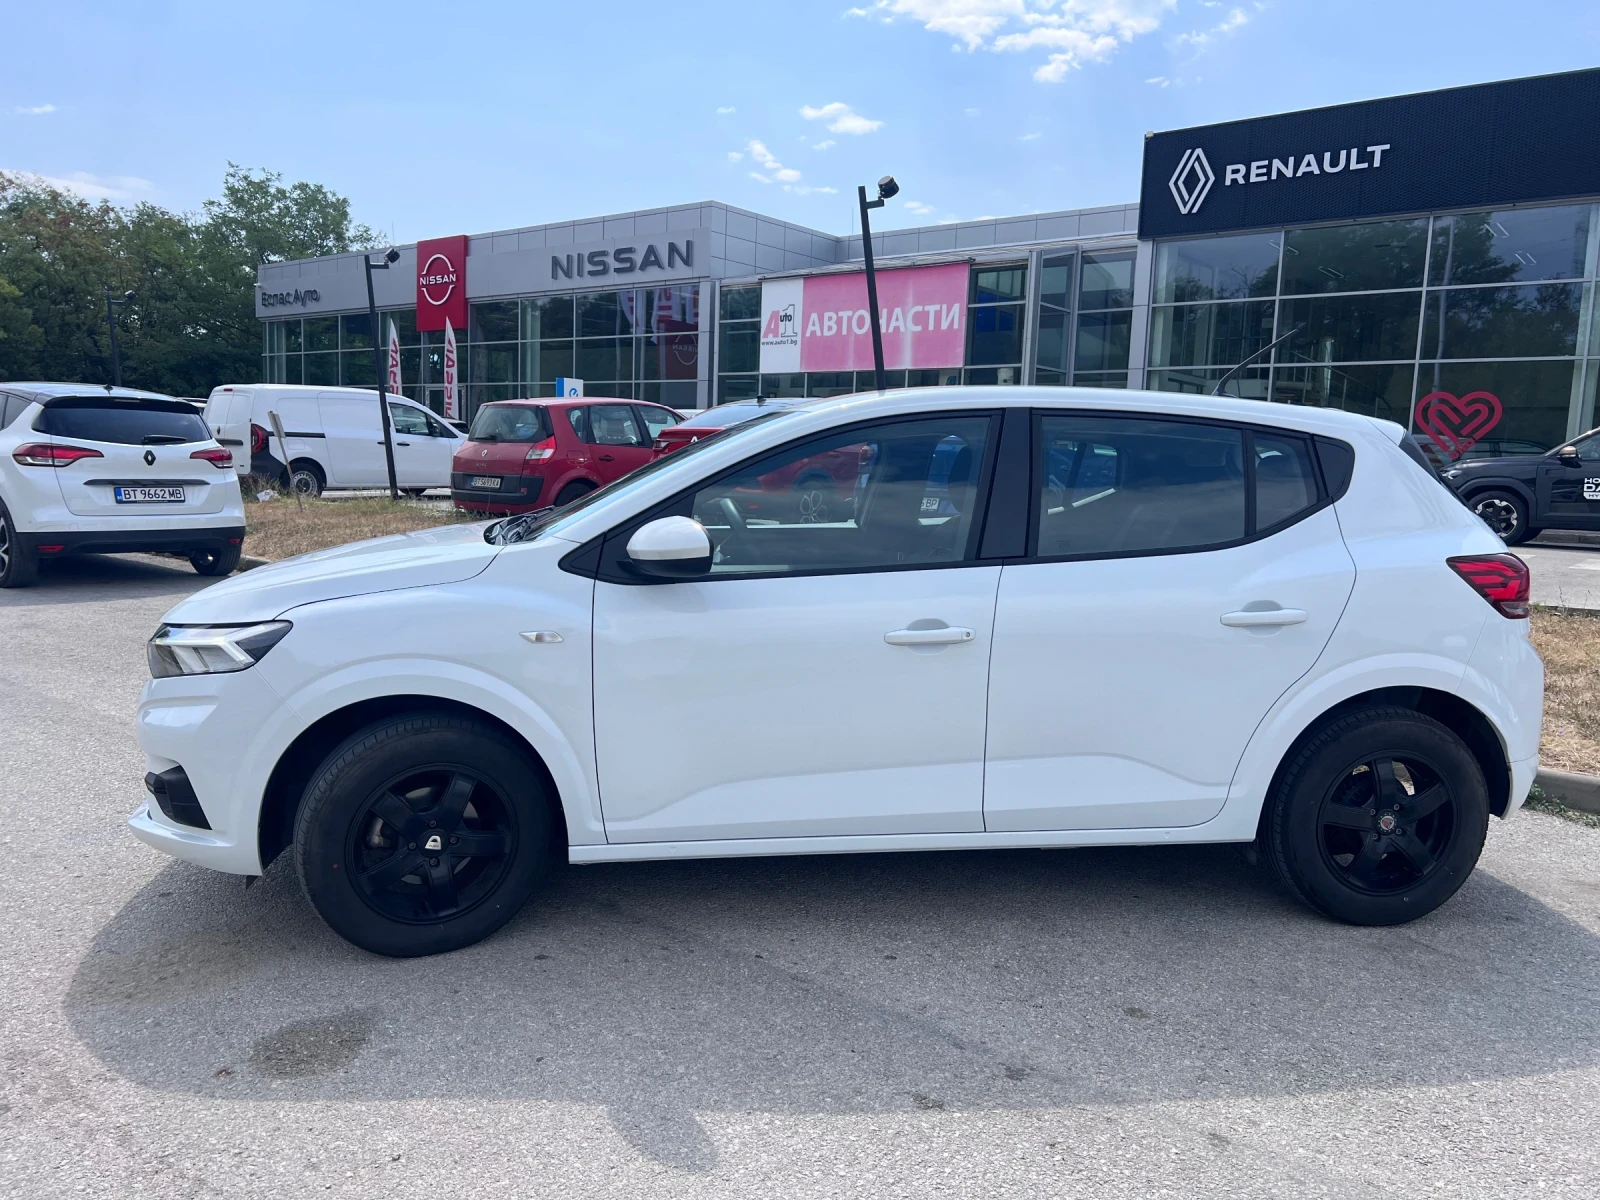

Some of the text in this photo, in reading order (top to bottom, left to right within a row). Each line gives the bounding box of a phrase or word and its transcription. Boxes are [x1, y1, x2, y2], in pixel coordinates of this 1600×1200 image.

[1224, 144, 1391, 186] RENAULT
[551, 239, 694, 280] NISSAN
[419, 273, 457, 286] NISSAN
[761, 338, 798, 346] www.auto1.bg
[140, 489, 167, 499] 9662
